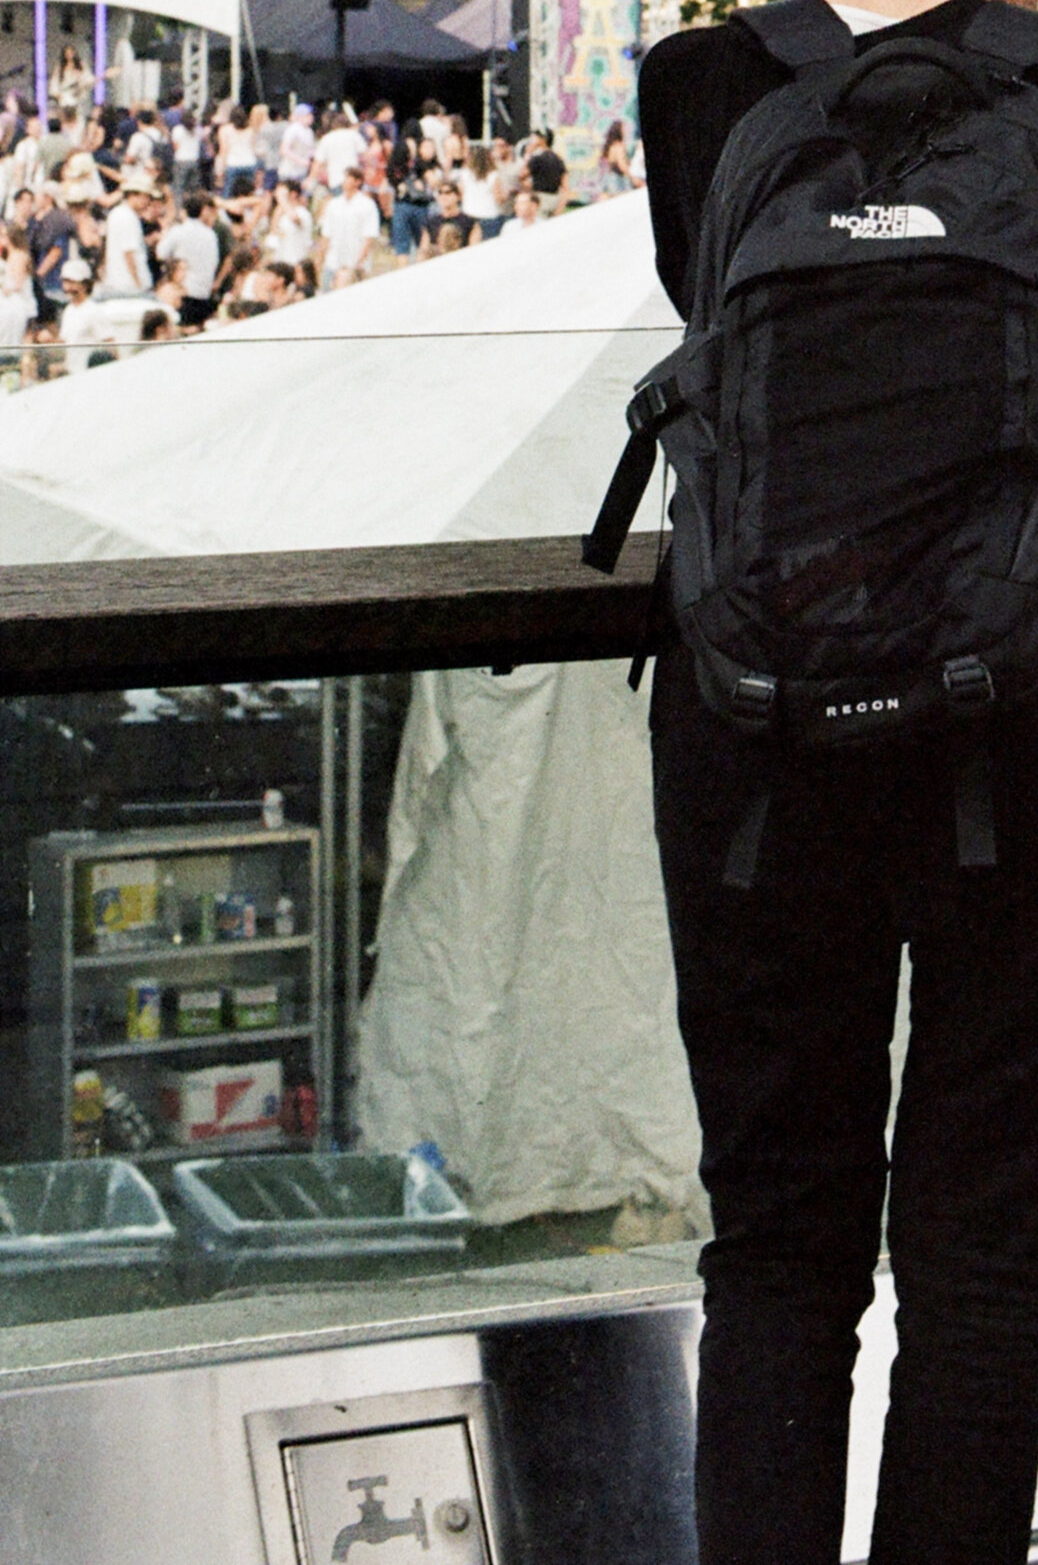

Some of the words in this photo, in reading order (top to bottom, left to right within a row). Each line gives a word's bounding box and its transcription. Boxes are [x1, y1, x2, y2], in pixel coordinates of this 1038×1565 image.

[864, 205, 908, 221] THE
[830, 214, 907, 232] NORTH
[826, 698, 899, 718] RECON
